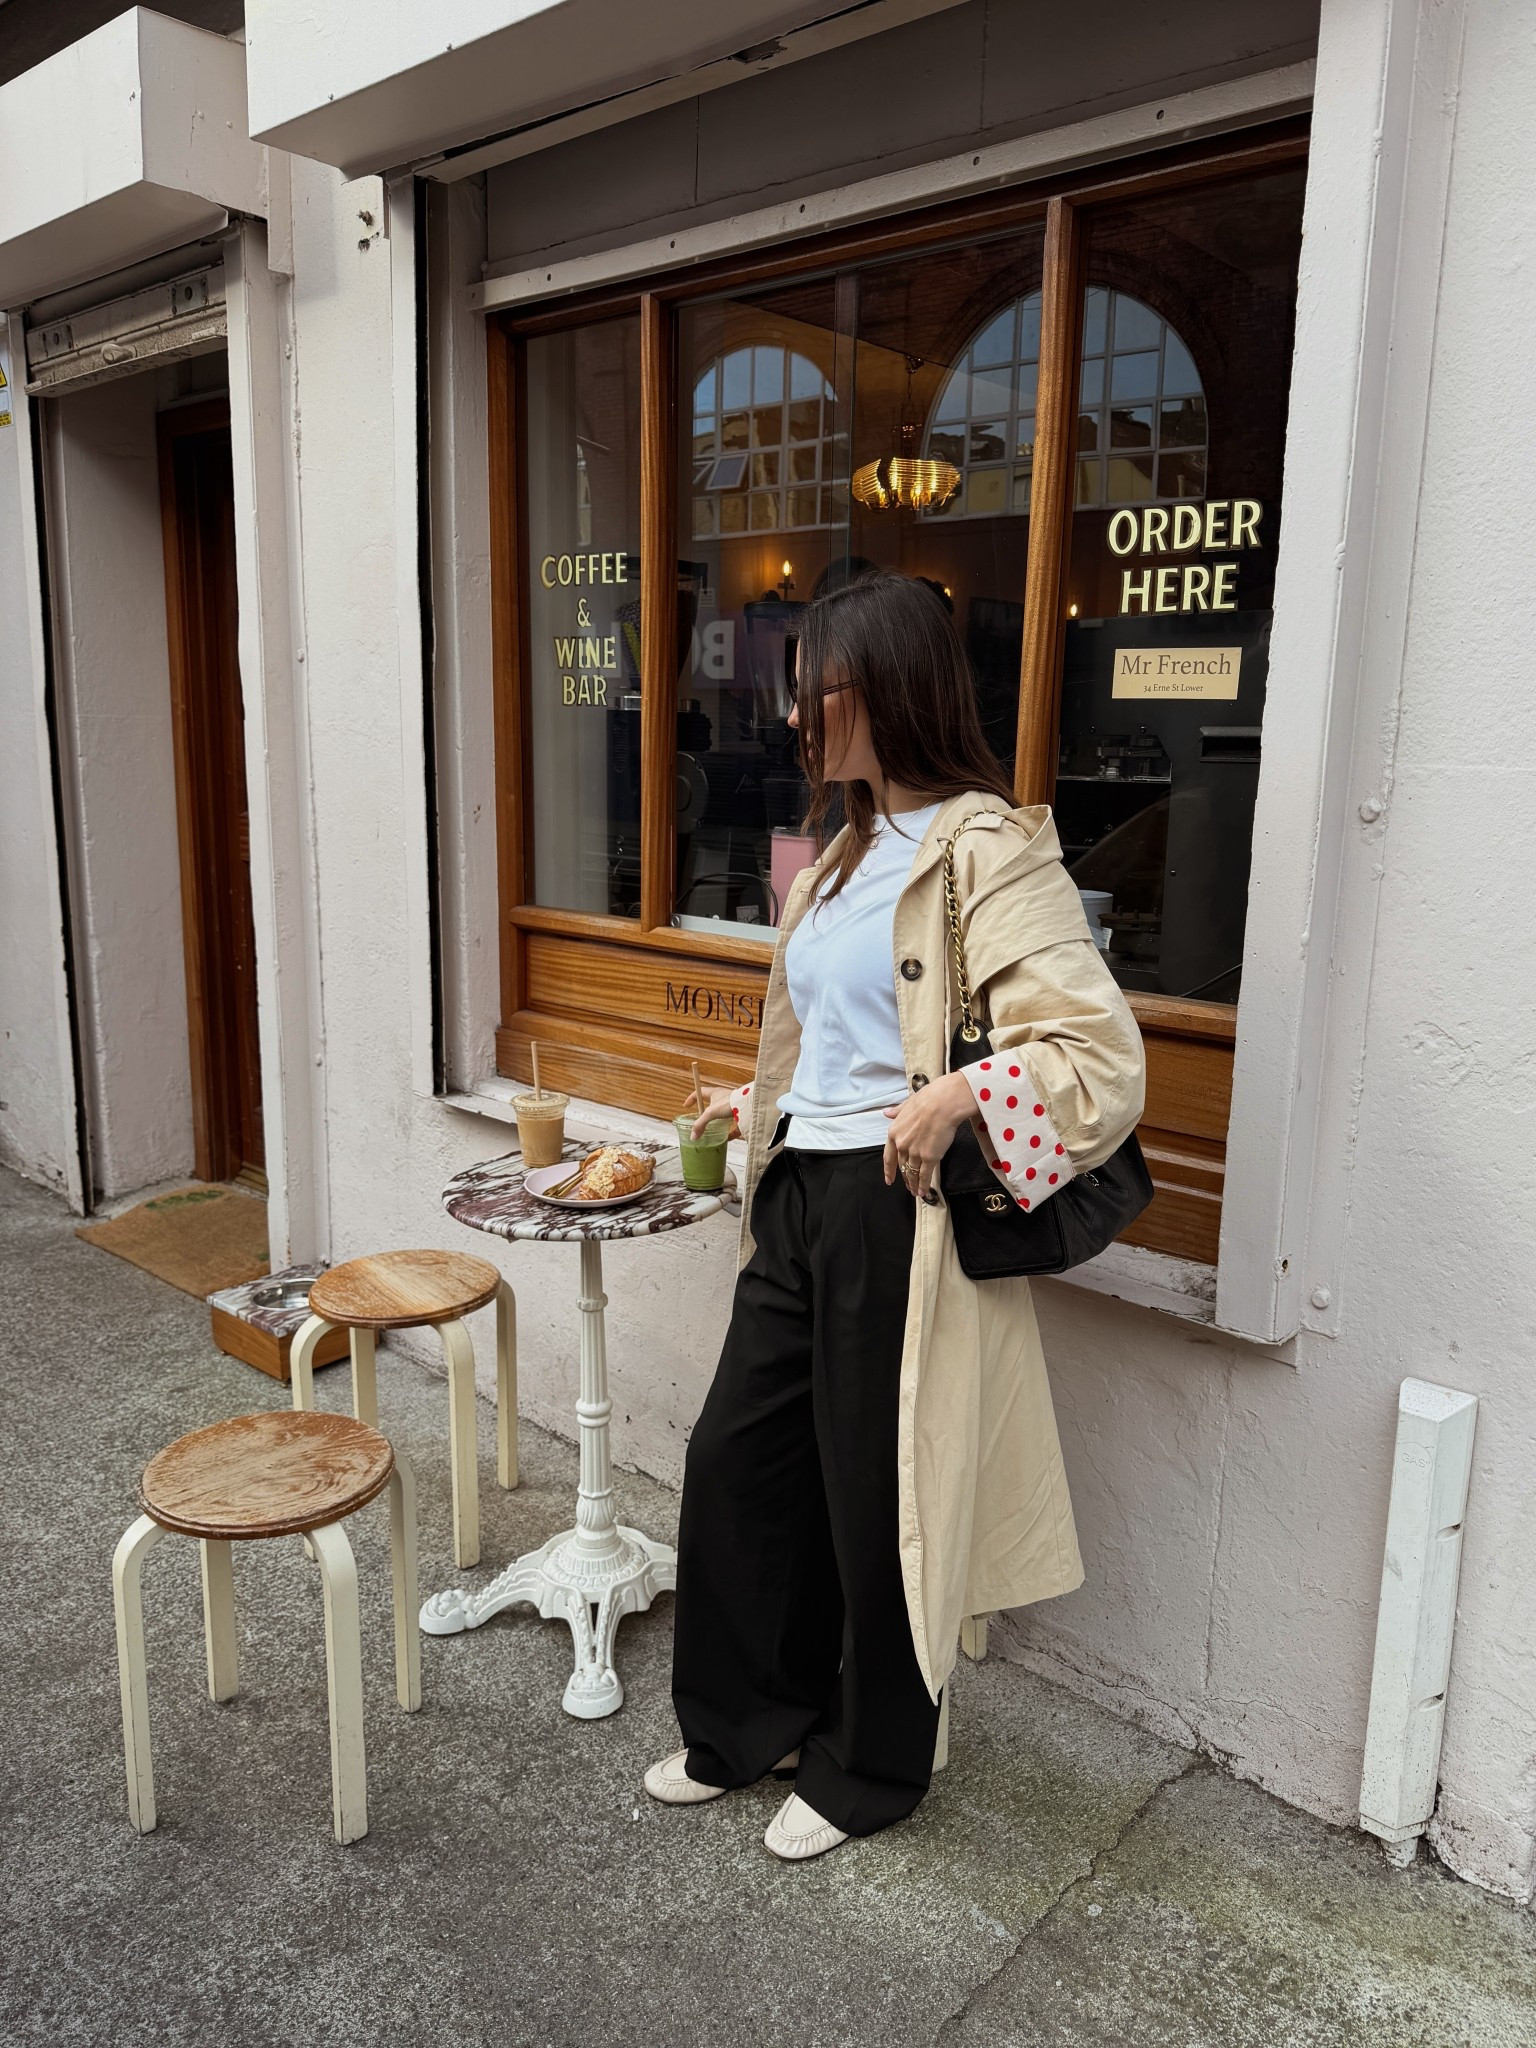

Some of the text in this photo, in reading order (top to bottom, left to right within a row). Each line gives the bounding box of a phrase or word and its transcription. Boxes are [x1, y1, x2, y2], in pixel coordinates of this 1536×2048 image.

[1107, 499, 1262, 556] ORDER
[540, 552, 628, 589] COFFEE
[1120, 563, 1238, 615] HERE
[577, 598, 592, 628] &
[554, 636, 617, 670] WINE
[1120, 652, 1232, 675] Mr French
[562, 674, 608, 706] BAR
[1143, 683, 1204, 693] 34 Erne St Lower
